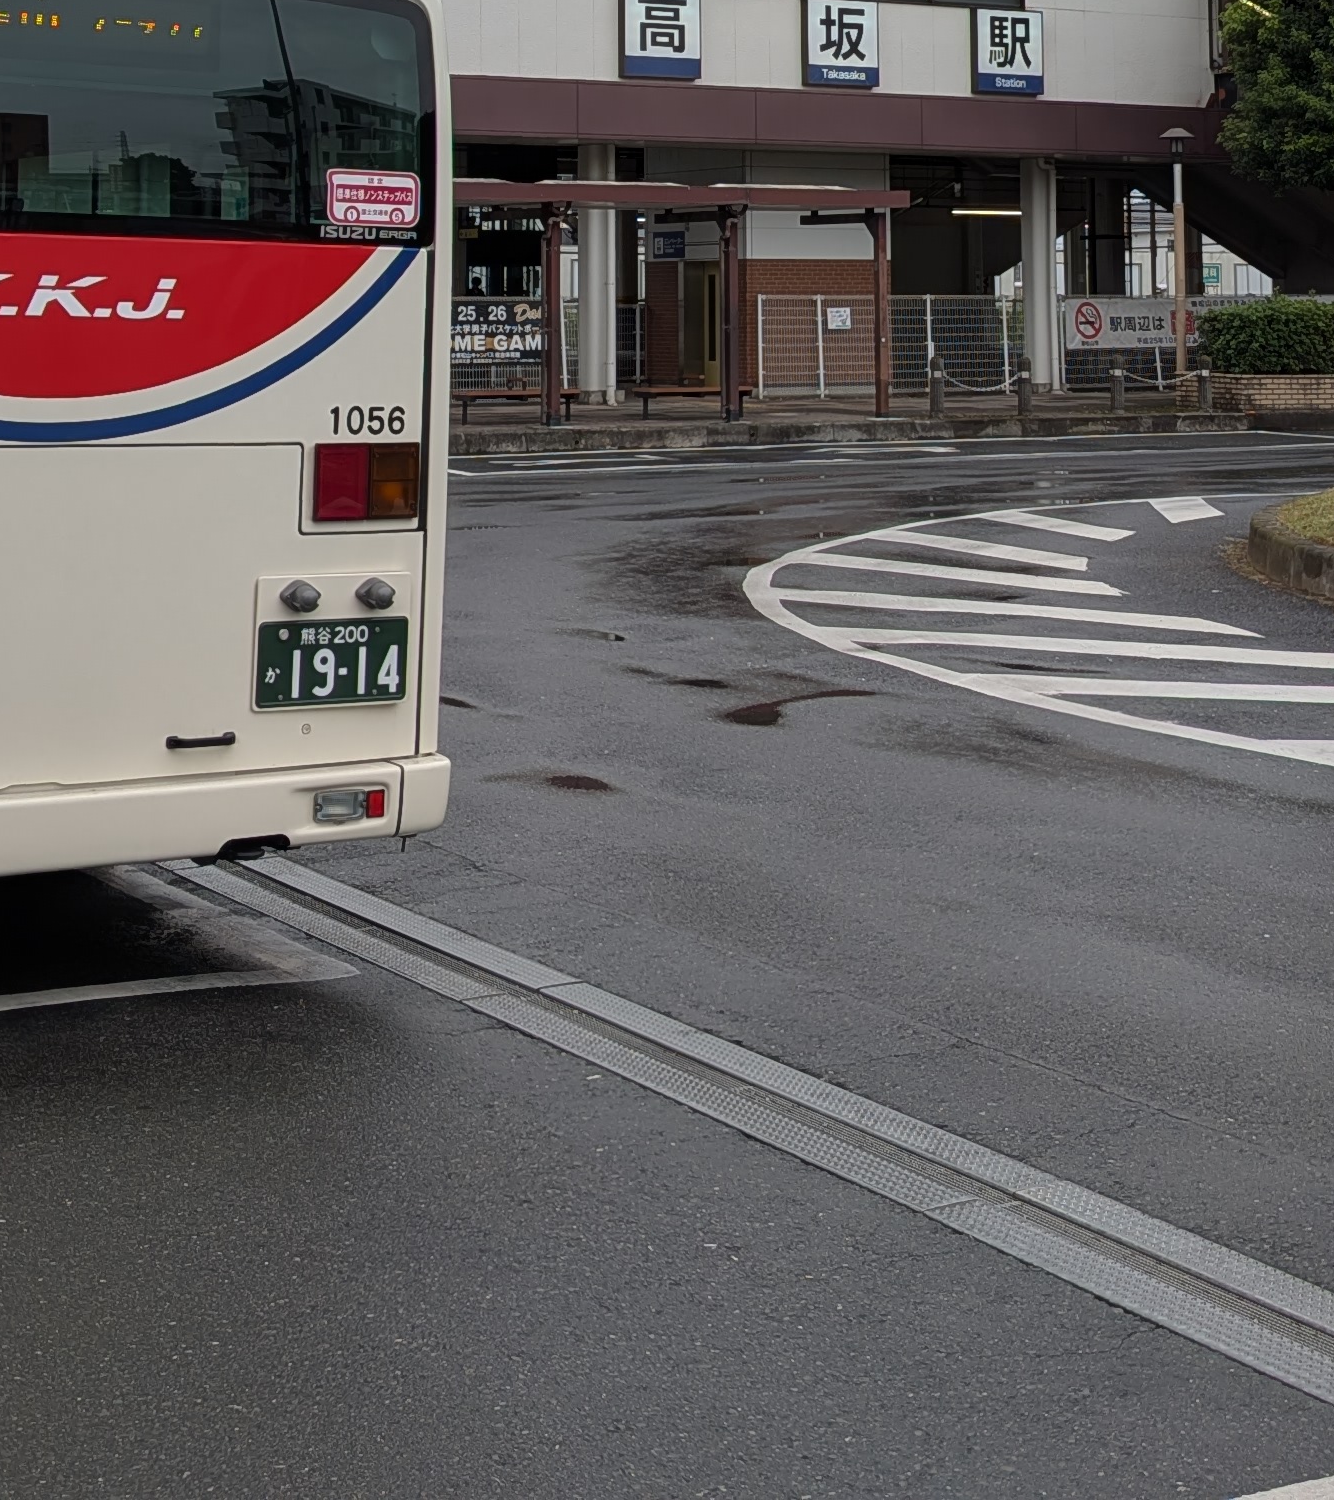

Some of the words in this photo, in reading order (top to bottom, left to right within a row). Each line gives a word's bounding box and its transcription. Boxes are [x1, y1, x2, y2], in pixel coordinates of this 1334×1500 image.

[821, 68, 867, 81] Takasaka
[995, 76, 1027, 88] Station
[319, 225, 377, 240] ISUZU
[378, 229, 418, 240] ERGA
[450, 335, 486, 352] ME
[493, 334, 548, 351] GAM
[329, 405, 406, 436] 1056
[264, 666, 281, 684] か
[290, 644, 400, 698] 19-14
